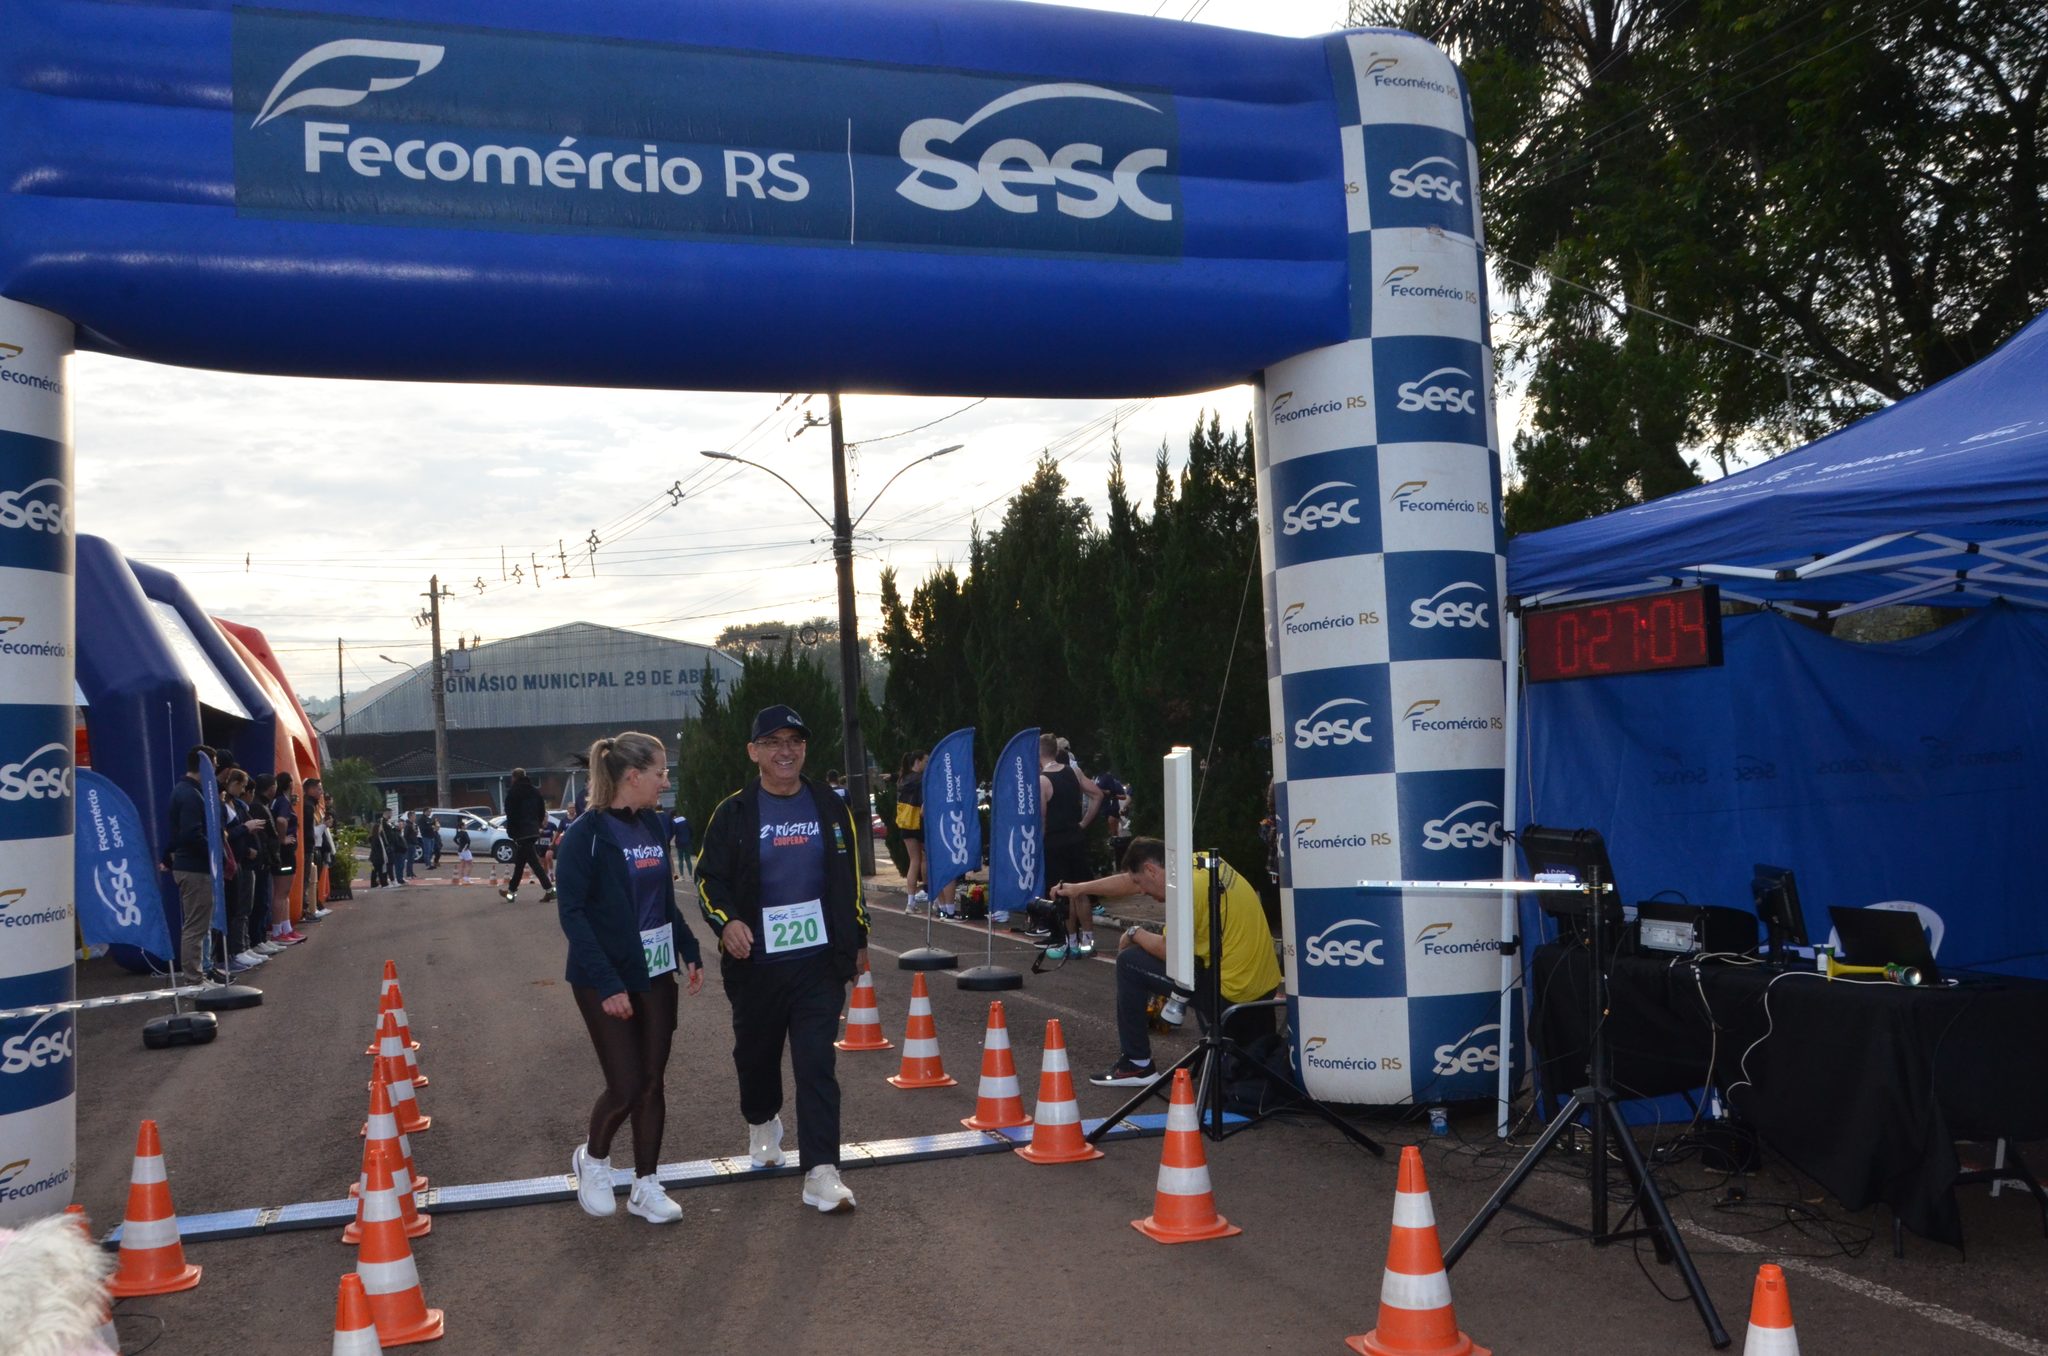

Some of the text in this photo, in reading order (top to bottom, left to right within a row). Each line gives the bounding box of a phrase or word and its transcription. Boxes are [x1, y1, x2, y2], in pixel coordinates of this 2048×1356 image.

[1374, 75, 1445, 93] Fecomércio
[304, 121, 810, 202] Fecomércio RS
[896, 110, 1173, 221] Sesc
[1389, 163, 1464, 205] Sesc
[1391, 284, 1477, 304] Fecomércio RS
[1274, 395, 1367, 425] Fecomércio RS
[1396, 377, 1476, 415] Sesc
[1282, 493, 1361, 536] Sesc
[1400, 498, 1489, 515] Fecomércio RS
[1286, 613, 1354, 635] Fecomércio
[1359, 611, 1380, 625] RS
[1409, 593, 1489, 628] Sesc
[445, 672, 517, 694] GINÁSIO
[523, 671, 619, 690] MUNICIPAL
[624, 670, 647, 685] 29
[651, 669, 673, 685] DE
[1294, 712, 1373, 749] Sesc
[1412, 716, 1503, 731] Fecomércio RS
[1015, 756, 1026, 815] Fecomércio
[88, 789, 109, 851] Fecomércio
[107, 815, 124, 848] Senac
[948, 810, 968, 865] Sesc
[1018, 825, 1035, 891] Sesc
[1298, 834, 1366, 849] Fecomércio
[1370, 832, 1391, 846] RS
[106, 857, 142, 927] Sesc
[772, 918, 819, 947] 220
[1305, 931, 1385, 967] Sesc
[1424, 938, 1501, 956] Fecomércio
[643, 942, 670, 972] 240
[1308, 1055, 1377, 1070] Fecomércio
[1381, 1057, 1402, 1070] RS
[1432, 1040, 1514, 1076] Ses
